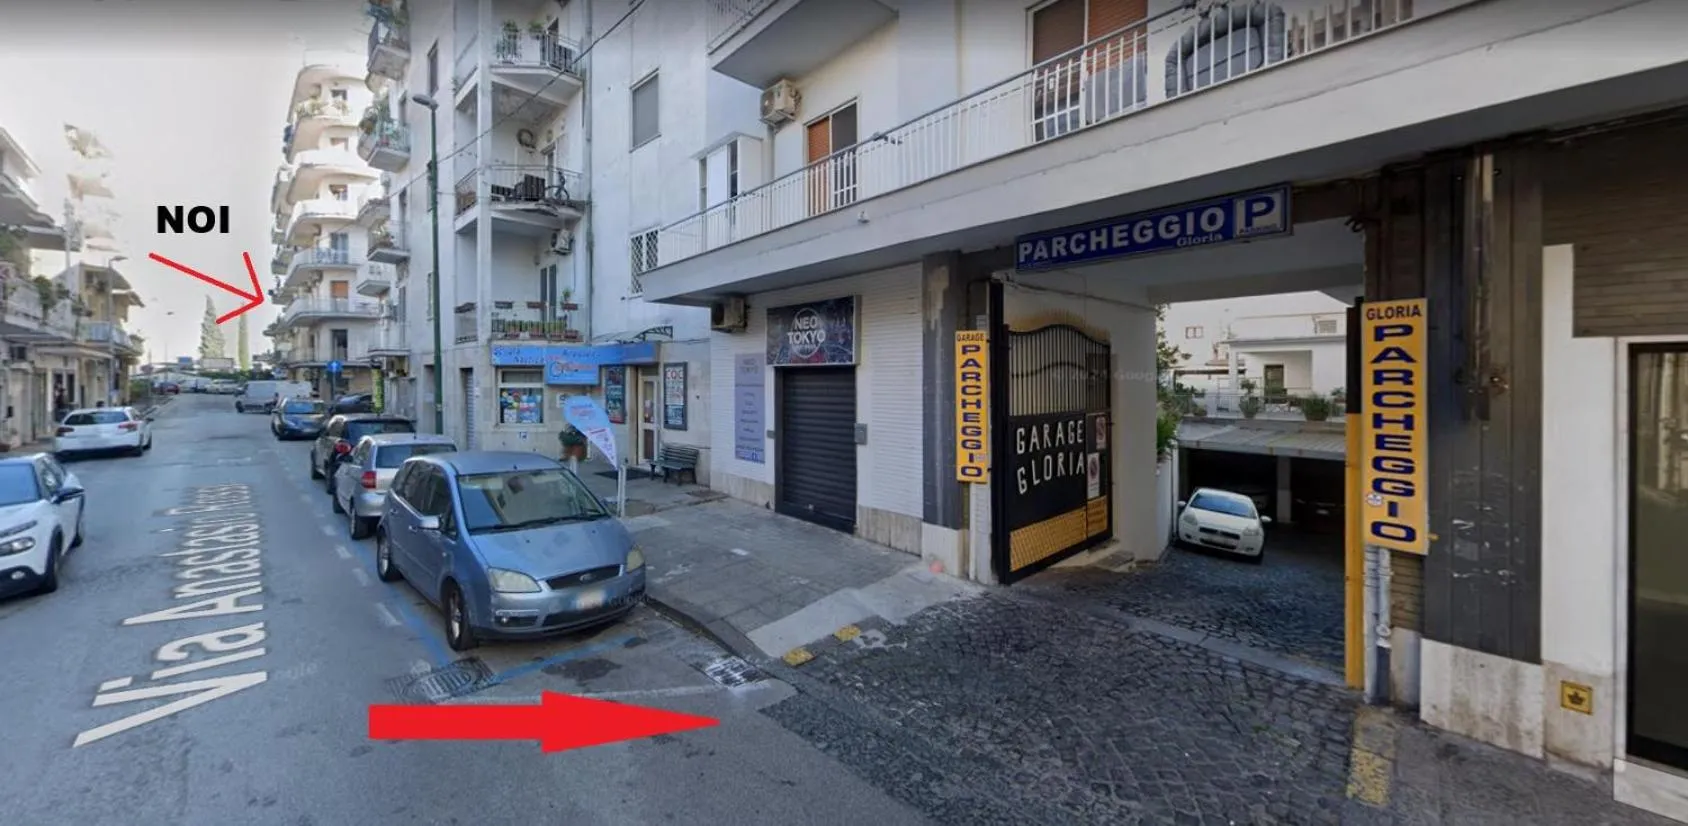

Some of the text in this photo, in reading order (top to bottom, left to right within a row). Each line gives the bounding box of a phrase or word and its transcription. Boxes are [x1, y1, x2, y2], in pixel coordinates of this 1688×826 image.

[1019, 195, 1275, 262] PARCHEGGIO P
[1177, 232, 1223, 248] Gloria
[794, 316, 818, 330] NEO
[1366, 305, 1421, 321] GLORIA
[787, 330, 827, 345] TOKYO
[957, 333, 985, 343] GARAGE
[960, 345, 982, 477] PARCHEGGIO
[1016, 420, 1084, 455] GARAGE
[1370, 324, 1417, 543] PARCHEGGIO
[1017, 453, 1085, 495] GLORIA
